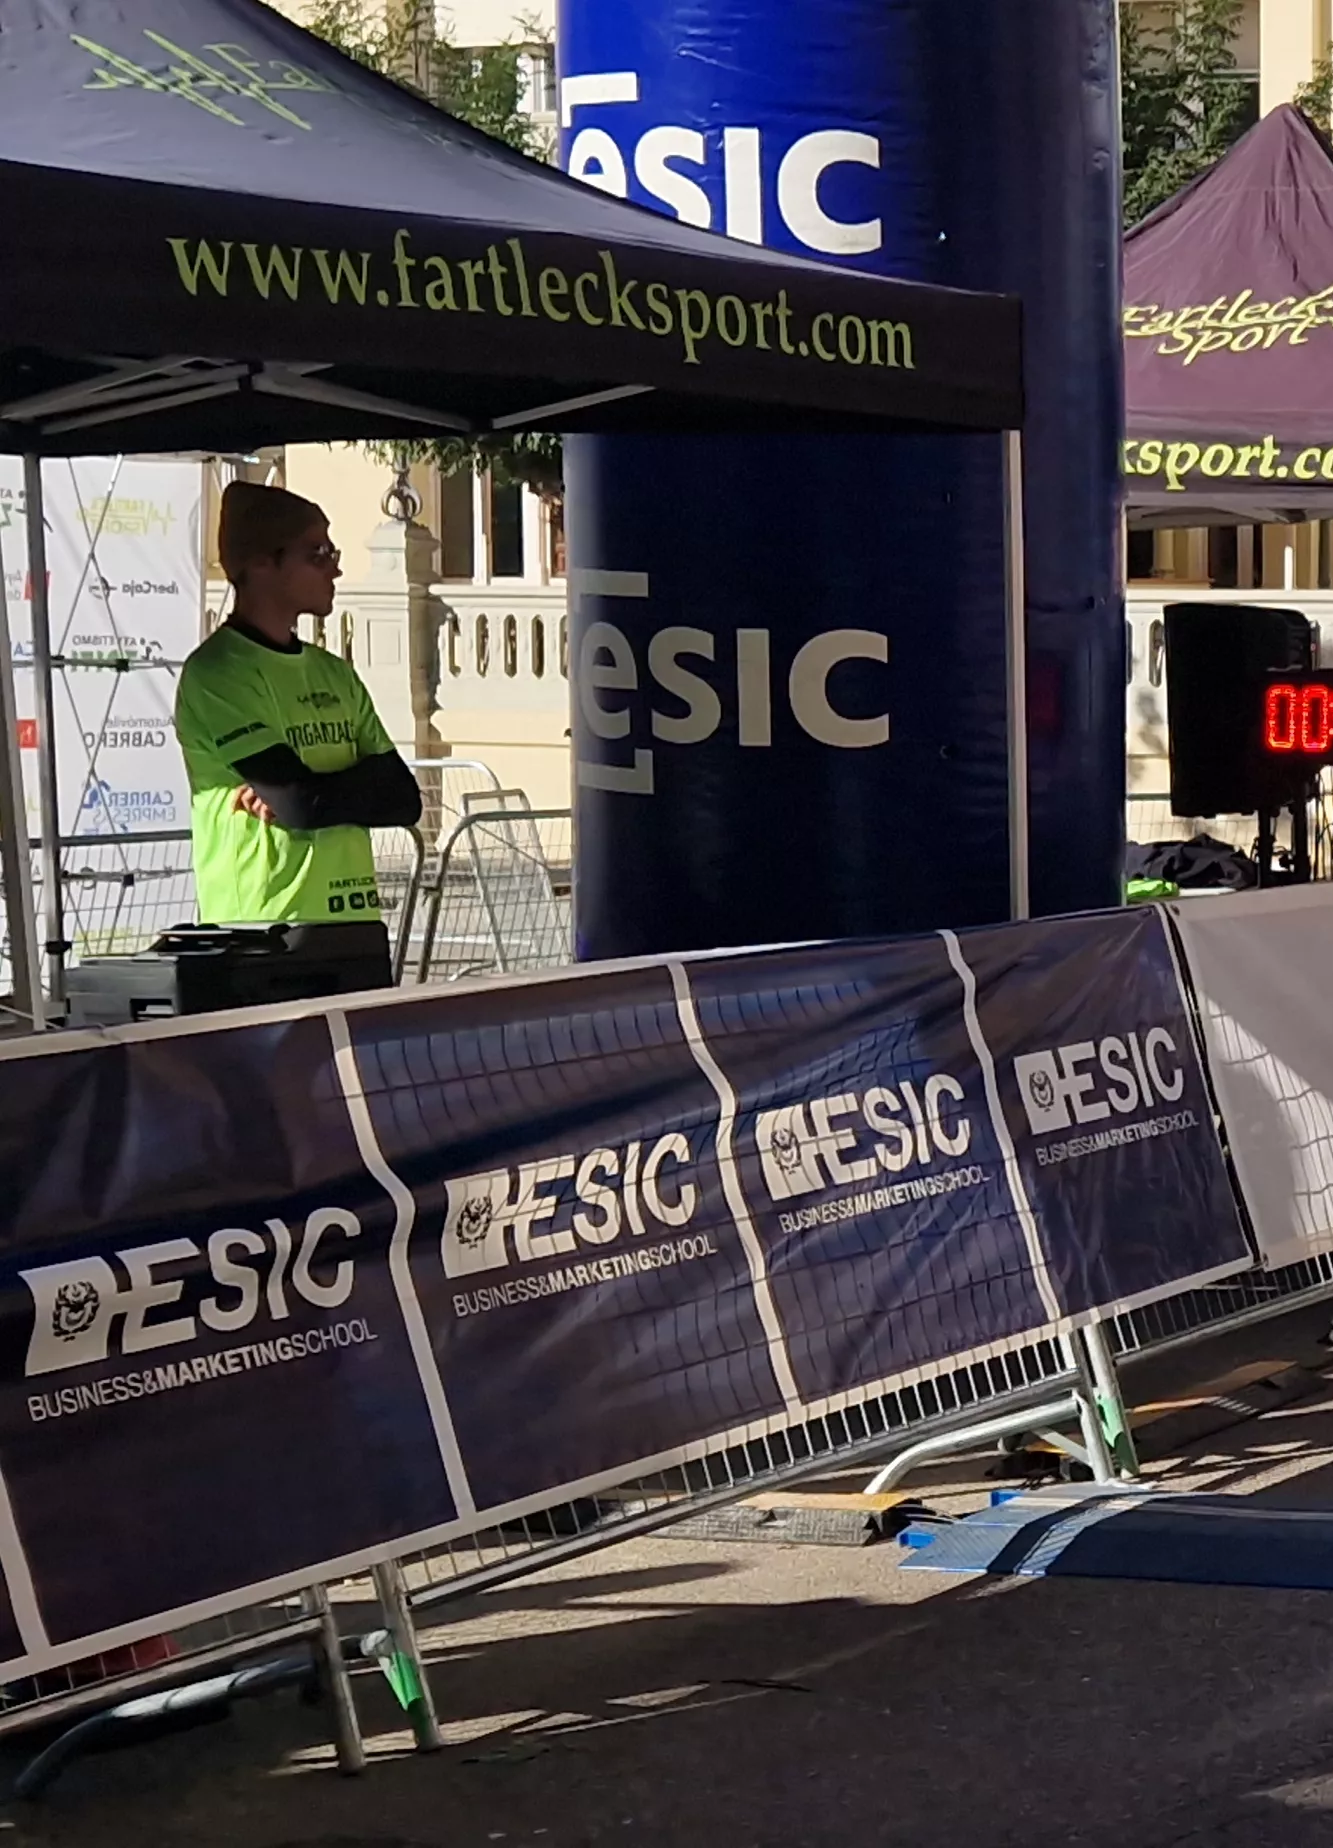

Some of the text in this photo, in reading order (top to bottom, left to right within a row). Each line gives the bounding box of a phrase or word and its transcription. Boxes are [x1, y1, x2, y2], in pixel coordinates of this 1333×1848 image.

[166, 229, 916, 370] www.fartlecksport.com
[1057, 1026, 1185, 1125] ESIC
[808, 1073, 971, 1188] ESIC
[1035, 1111, 1200, 1167] BUSINESS&MARKETINGSCHOOL
[510, 1132, 691, 1262] ESIC
[779, 1163, 991, 1234] BUSINESS&MARKETINGSCHOOL
[115, 1206, 361, 1356] ESIC
[453, 1234, 717, 1318] BUSINESS&MARKETINGSCHOOL
[27, 1317, 378, 1423] BUSINESS&MARKETINGSCHOOL
